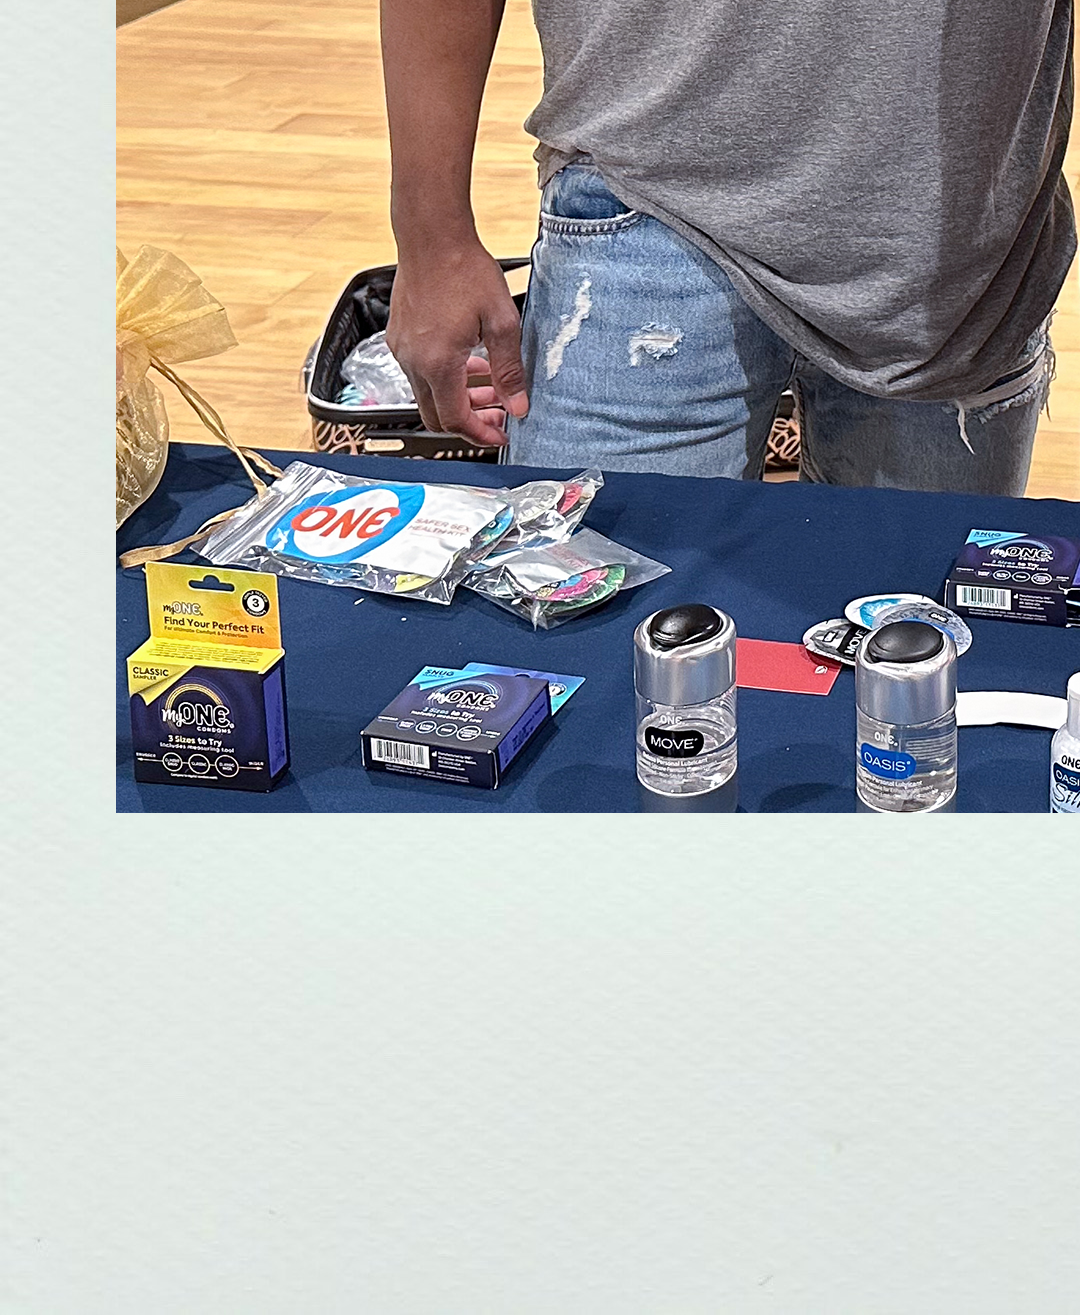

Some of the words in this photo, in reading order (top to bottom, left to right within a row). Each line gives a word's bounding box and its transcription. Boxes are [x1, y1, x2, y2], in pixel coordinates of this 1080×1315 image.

[290, 505, 401, 540] ONE
[415, 518, 449, 531] SAFER
[450, 523, 472, 533] SEX
[408, 524, 448, 536] HEALTH
[449, 529, 466, 537] KIT
[252, 597, 260, 607] 3
[164, 616, 185, 626] Find
[187, 618, 210, 629] Your
[212, 621, 249, 633] Perfect
[251, 625, 265, 634] Fit
[132, 666, 169, 677] CLASSIC
[424, 668, 455, 677] SNUG
[196, 726, 231, 734] CONDOMS
[160, 742, 186, 750] Includes
[174, 735, 196, 744] Sizes
[197, 737, 207, 745] to
[208, 738, 222, 747] Try
[650, 735, 695, 750] MOVE
[864, 752, 906, 772] OASIS
